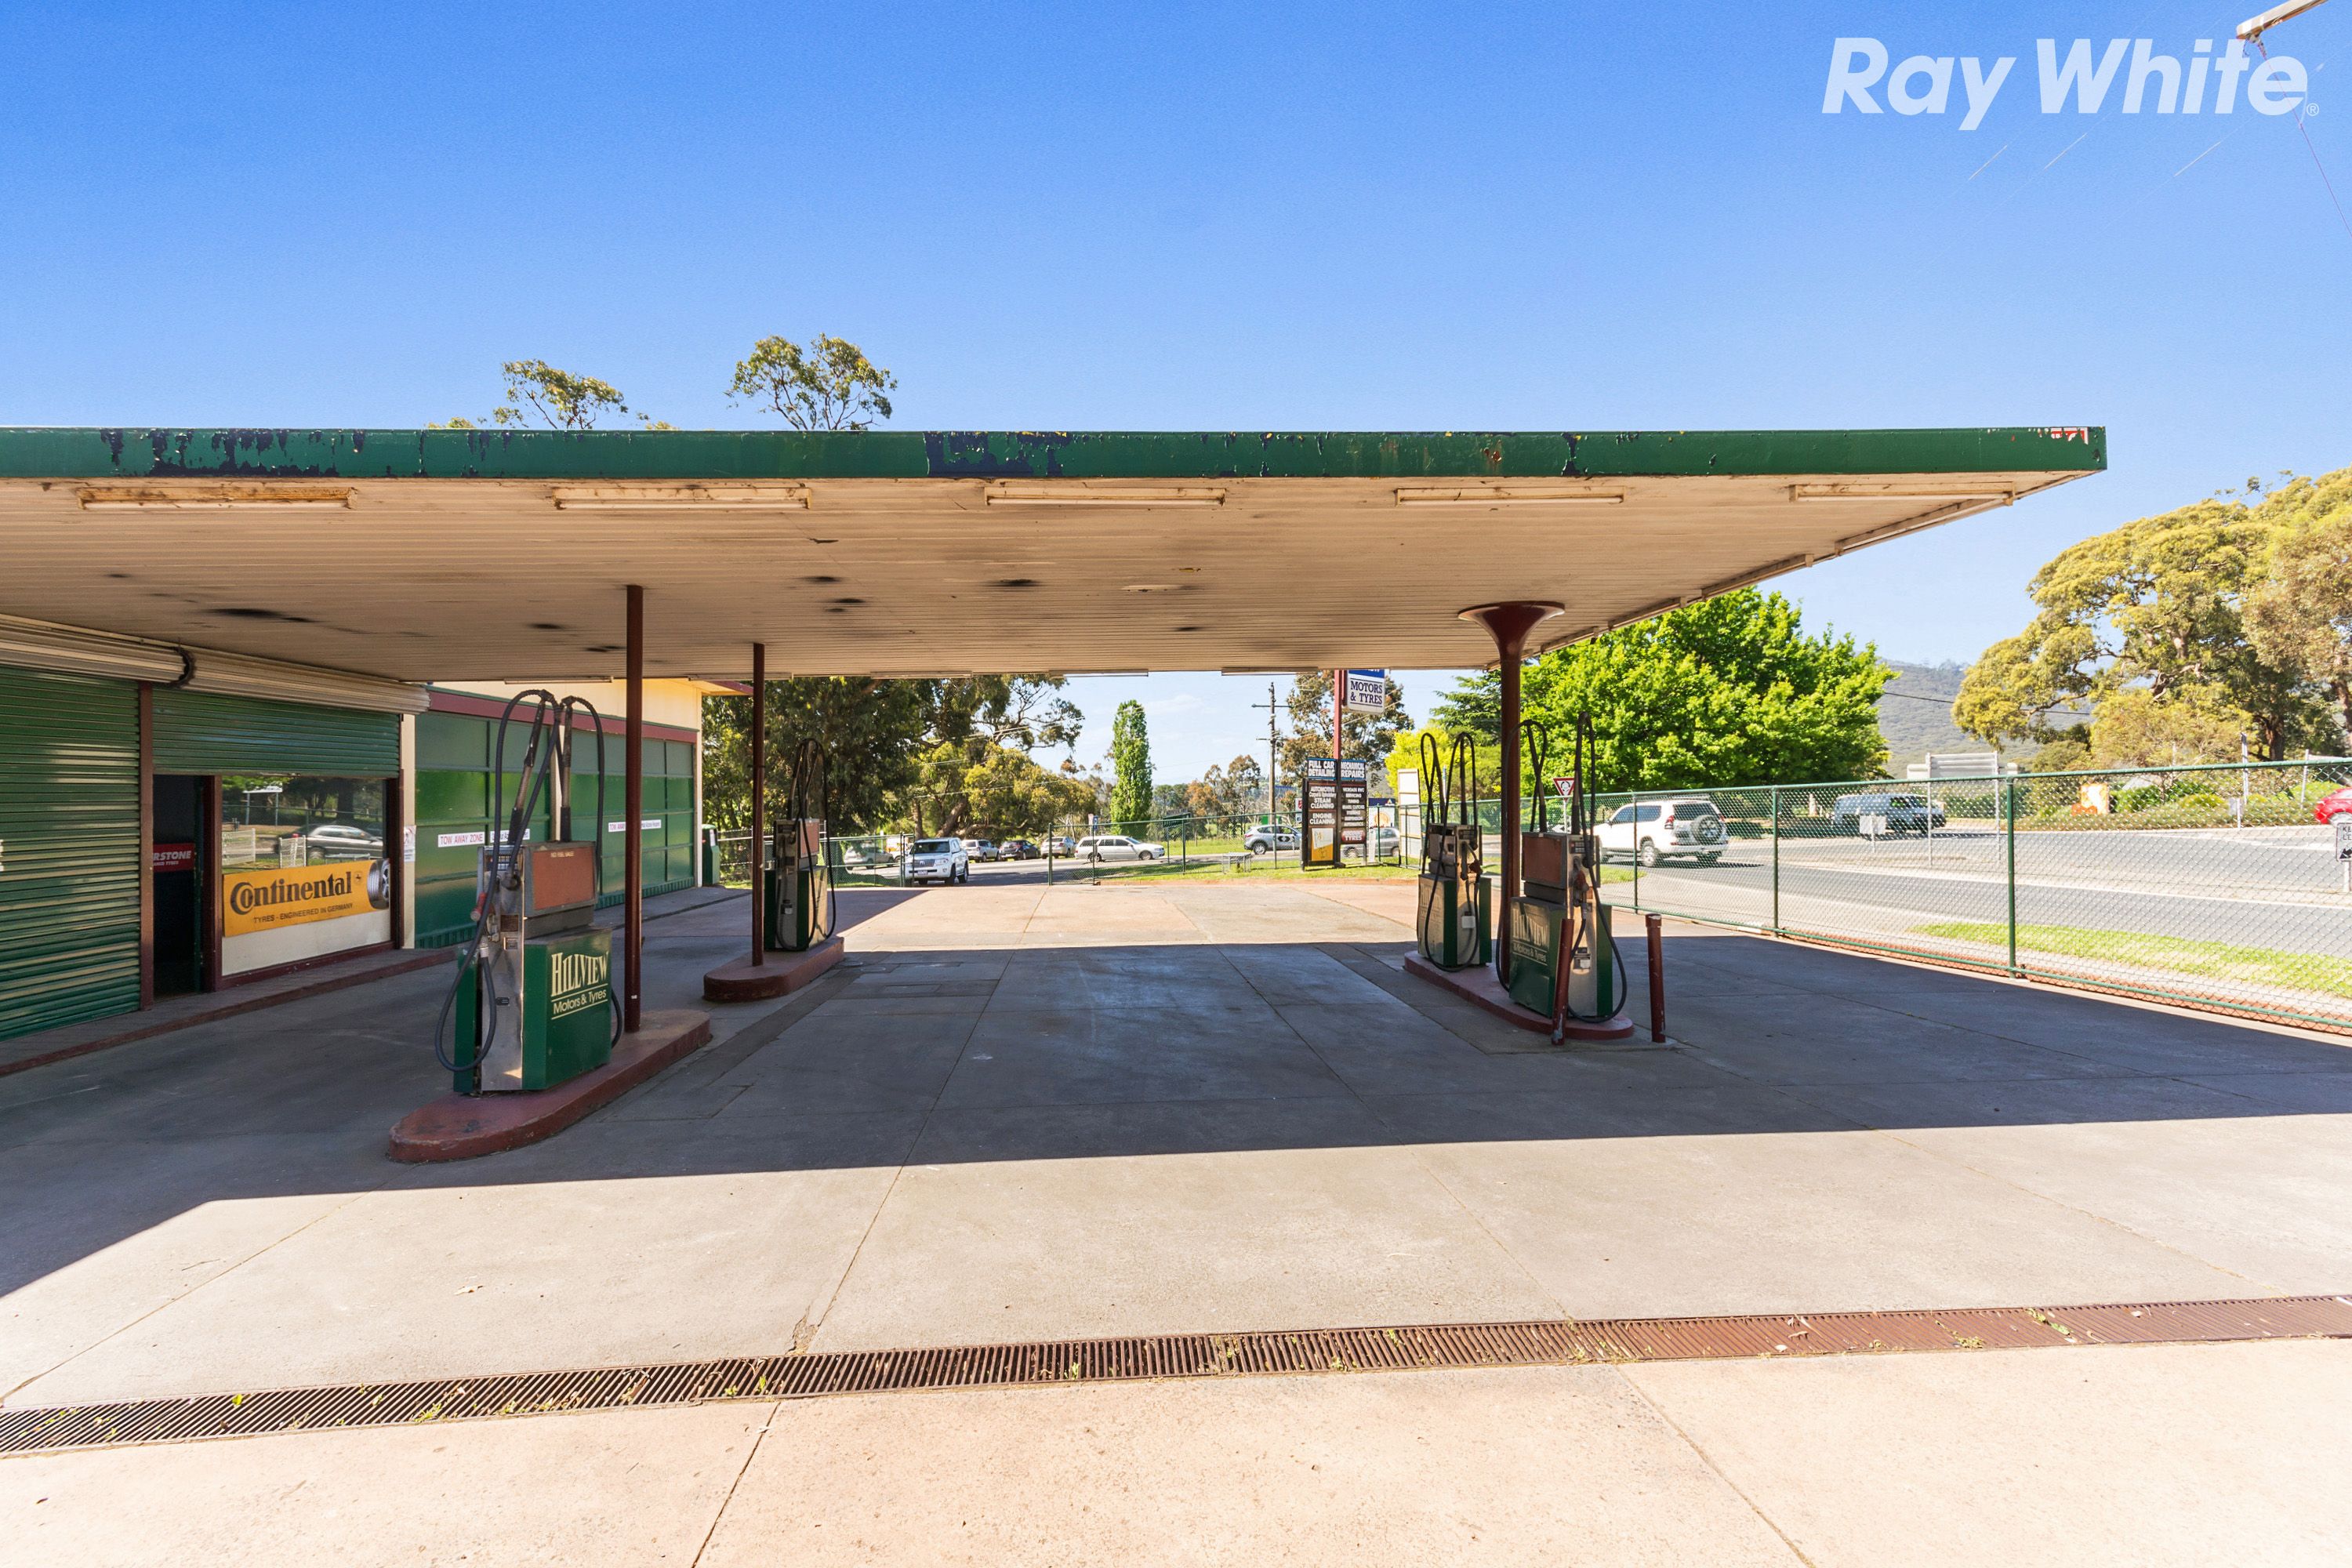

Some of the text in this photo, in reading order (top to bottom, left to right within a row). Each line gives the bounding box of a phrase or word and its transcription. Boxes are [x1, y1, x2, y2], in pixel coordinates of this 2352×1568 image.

[1350, 681, 1382, 694] MOTORS
[1350, 691, 1382, 705] & TYRES
[1323, 760, 1334, 769] CAR
[1341, 761, 1365, 770] MECHANICAL
[1308, 768, 1335, 777] DETAILING
[440, 836, 452, 845] TOW
[454, 834, 468, 844] AWAY
[470, 833, 483, 842] ZONE
[230, 871, 352, 915] Continental
[254, 914, 274, 924] TYRES
[280, 909, 319, 920] ENGINEERED
[328, 902, 353, 913] GERMANY
[551, 951, 609, 997] HILLVIEW
[554, 989, 606, 1014] Motors & Tyres
